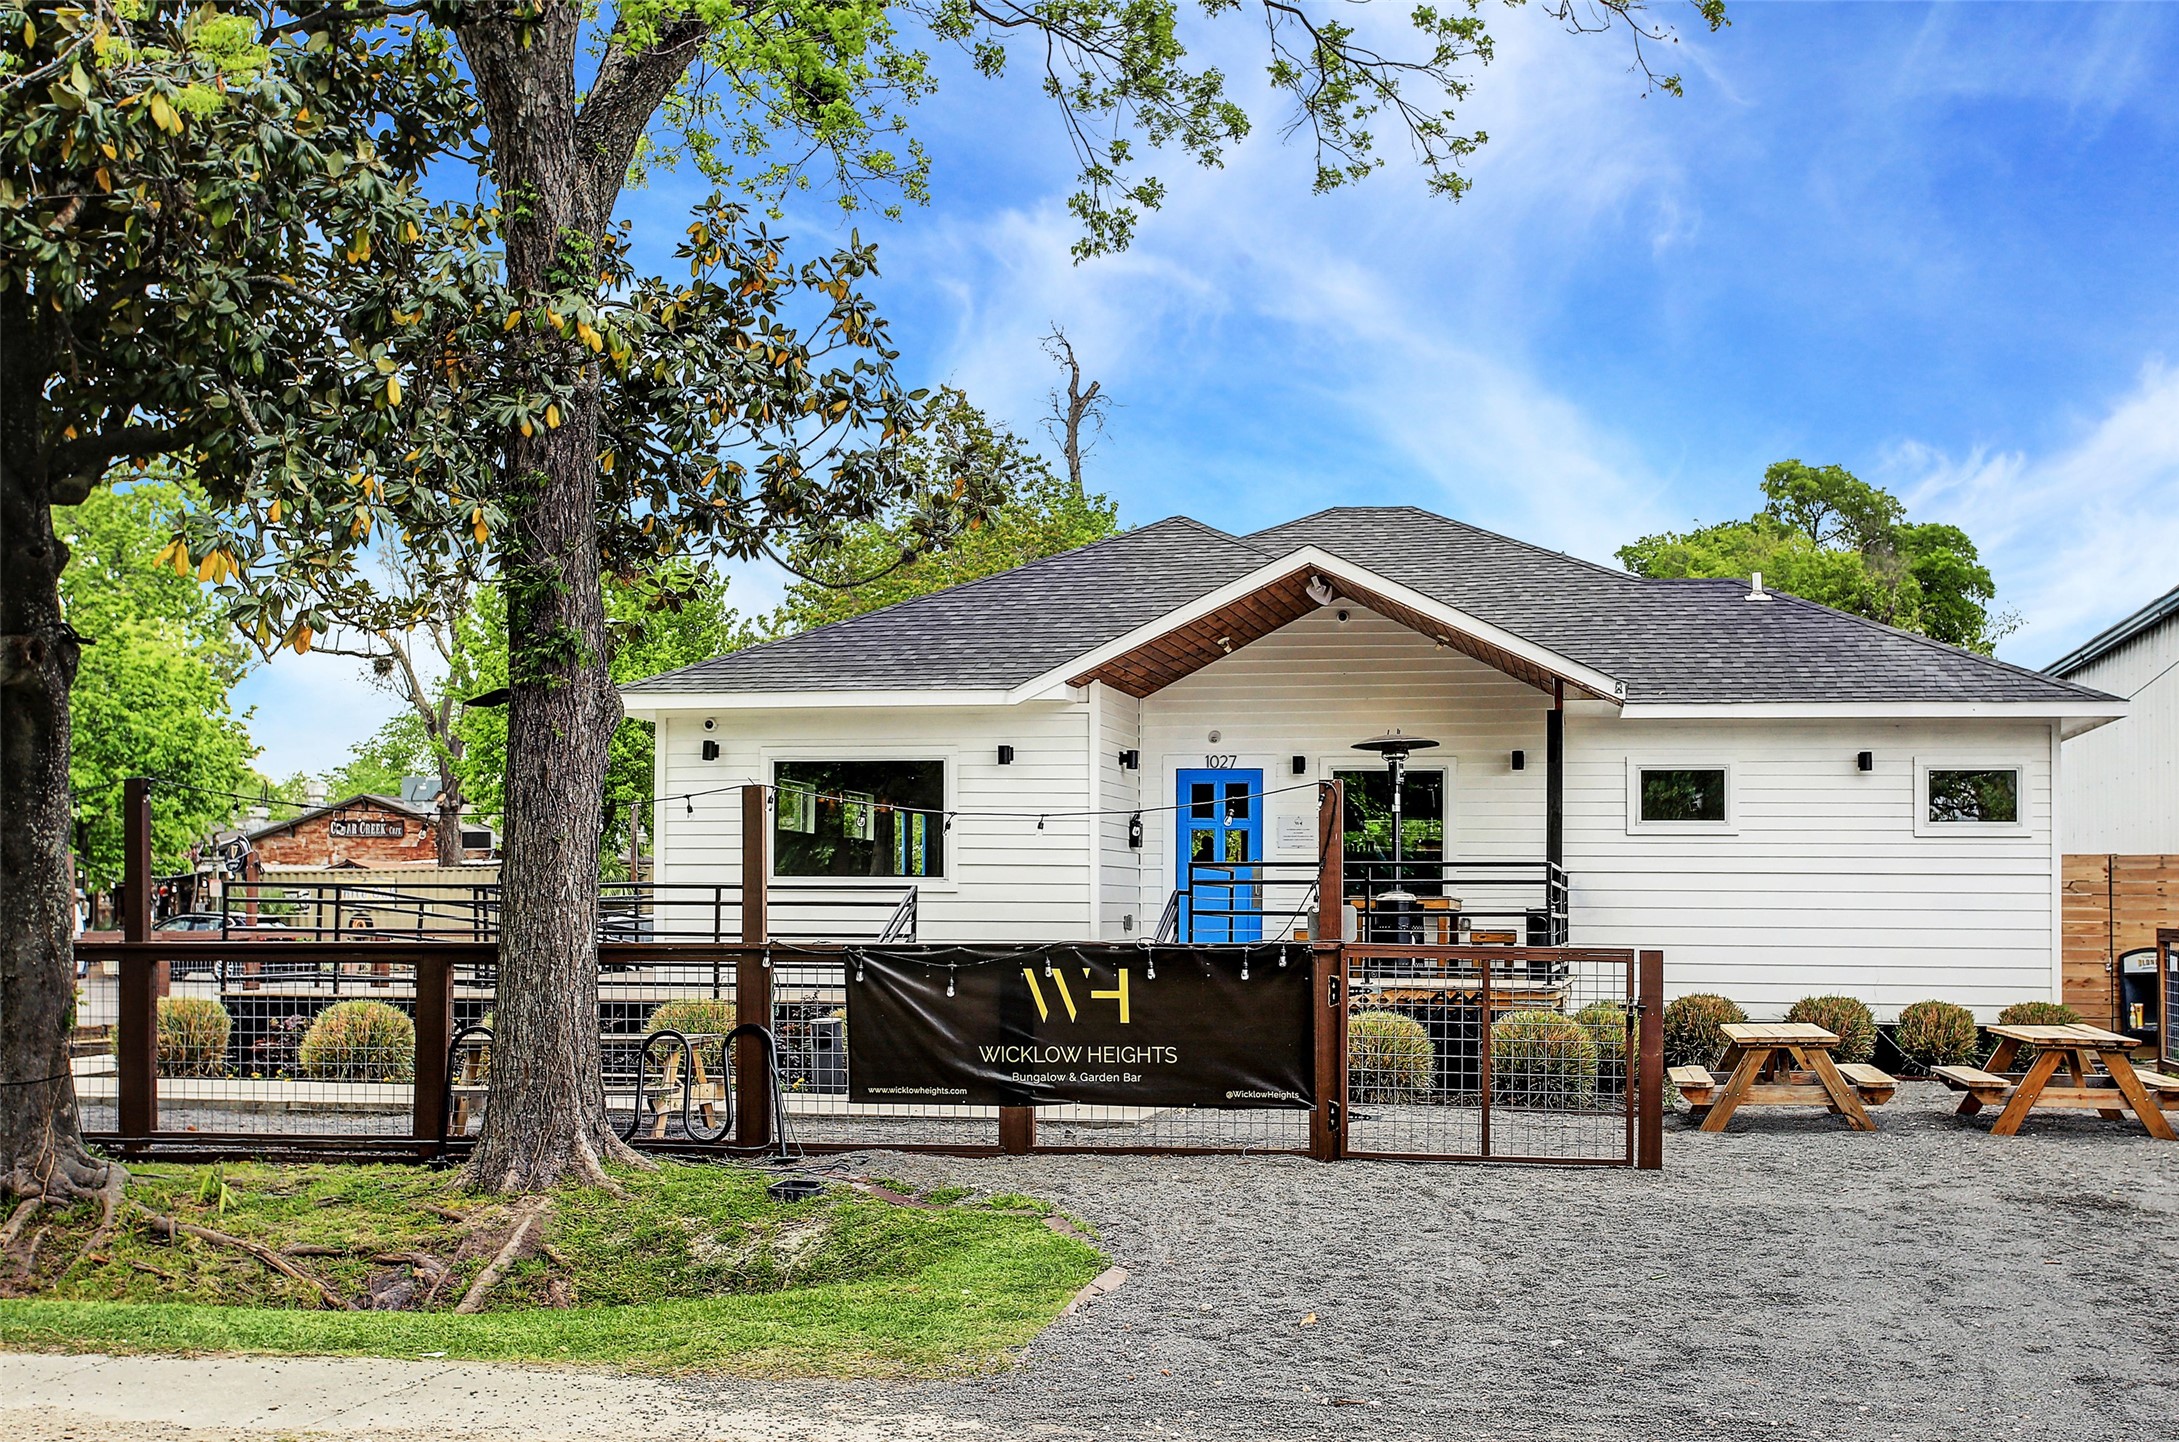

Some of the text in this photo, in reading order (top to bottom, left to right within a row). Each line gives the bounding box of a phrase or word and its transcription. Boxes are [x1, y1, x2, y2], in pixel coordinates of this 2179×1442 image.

[1205, 754, 1237, 769] 1027
[360, 821, 387, 835] CREEK
[978, 1045, 1178, 1064] WICKLOW HEIGHTS
[1011, 1072, 1142, 1084] Bungalow & Garden Bar
[867, 1086, 968, 1096] www.wicklowheights.com
[1225, 1090, 1300, 1101] @WicklowHeights
